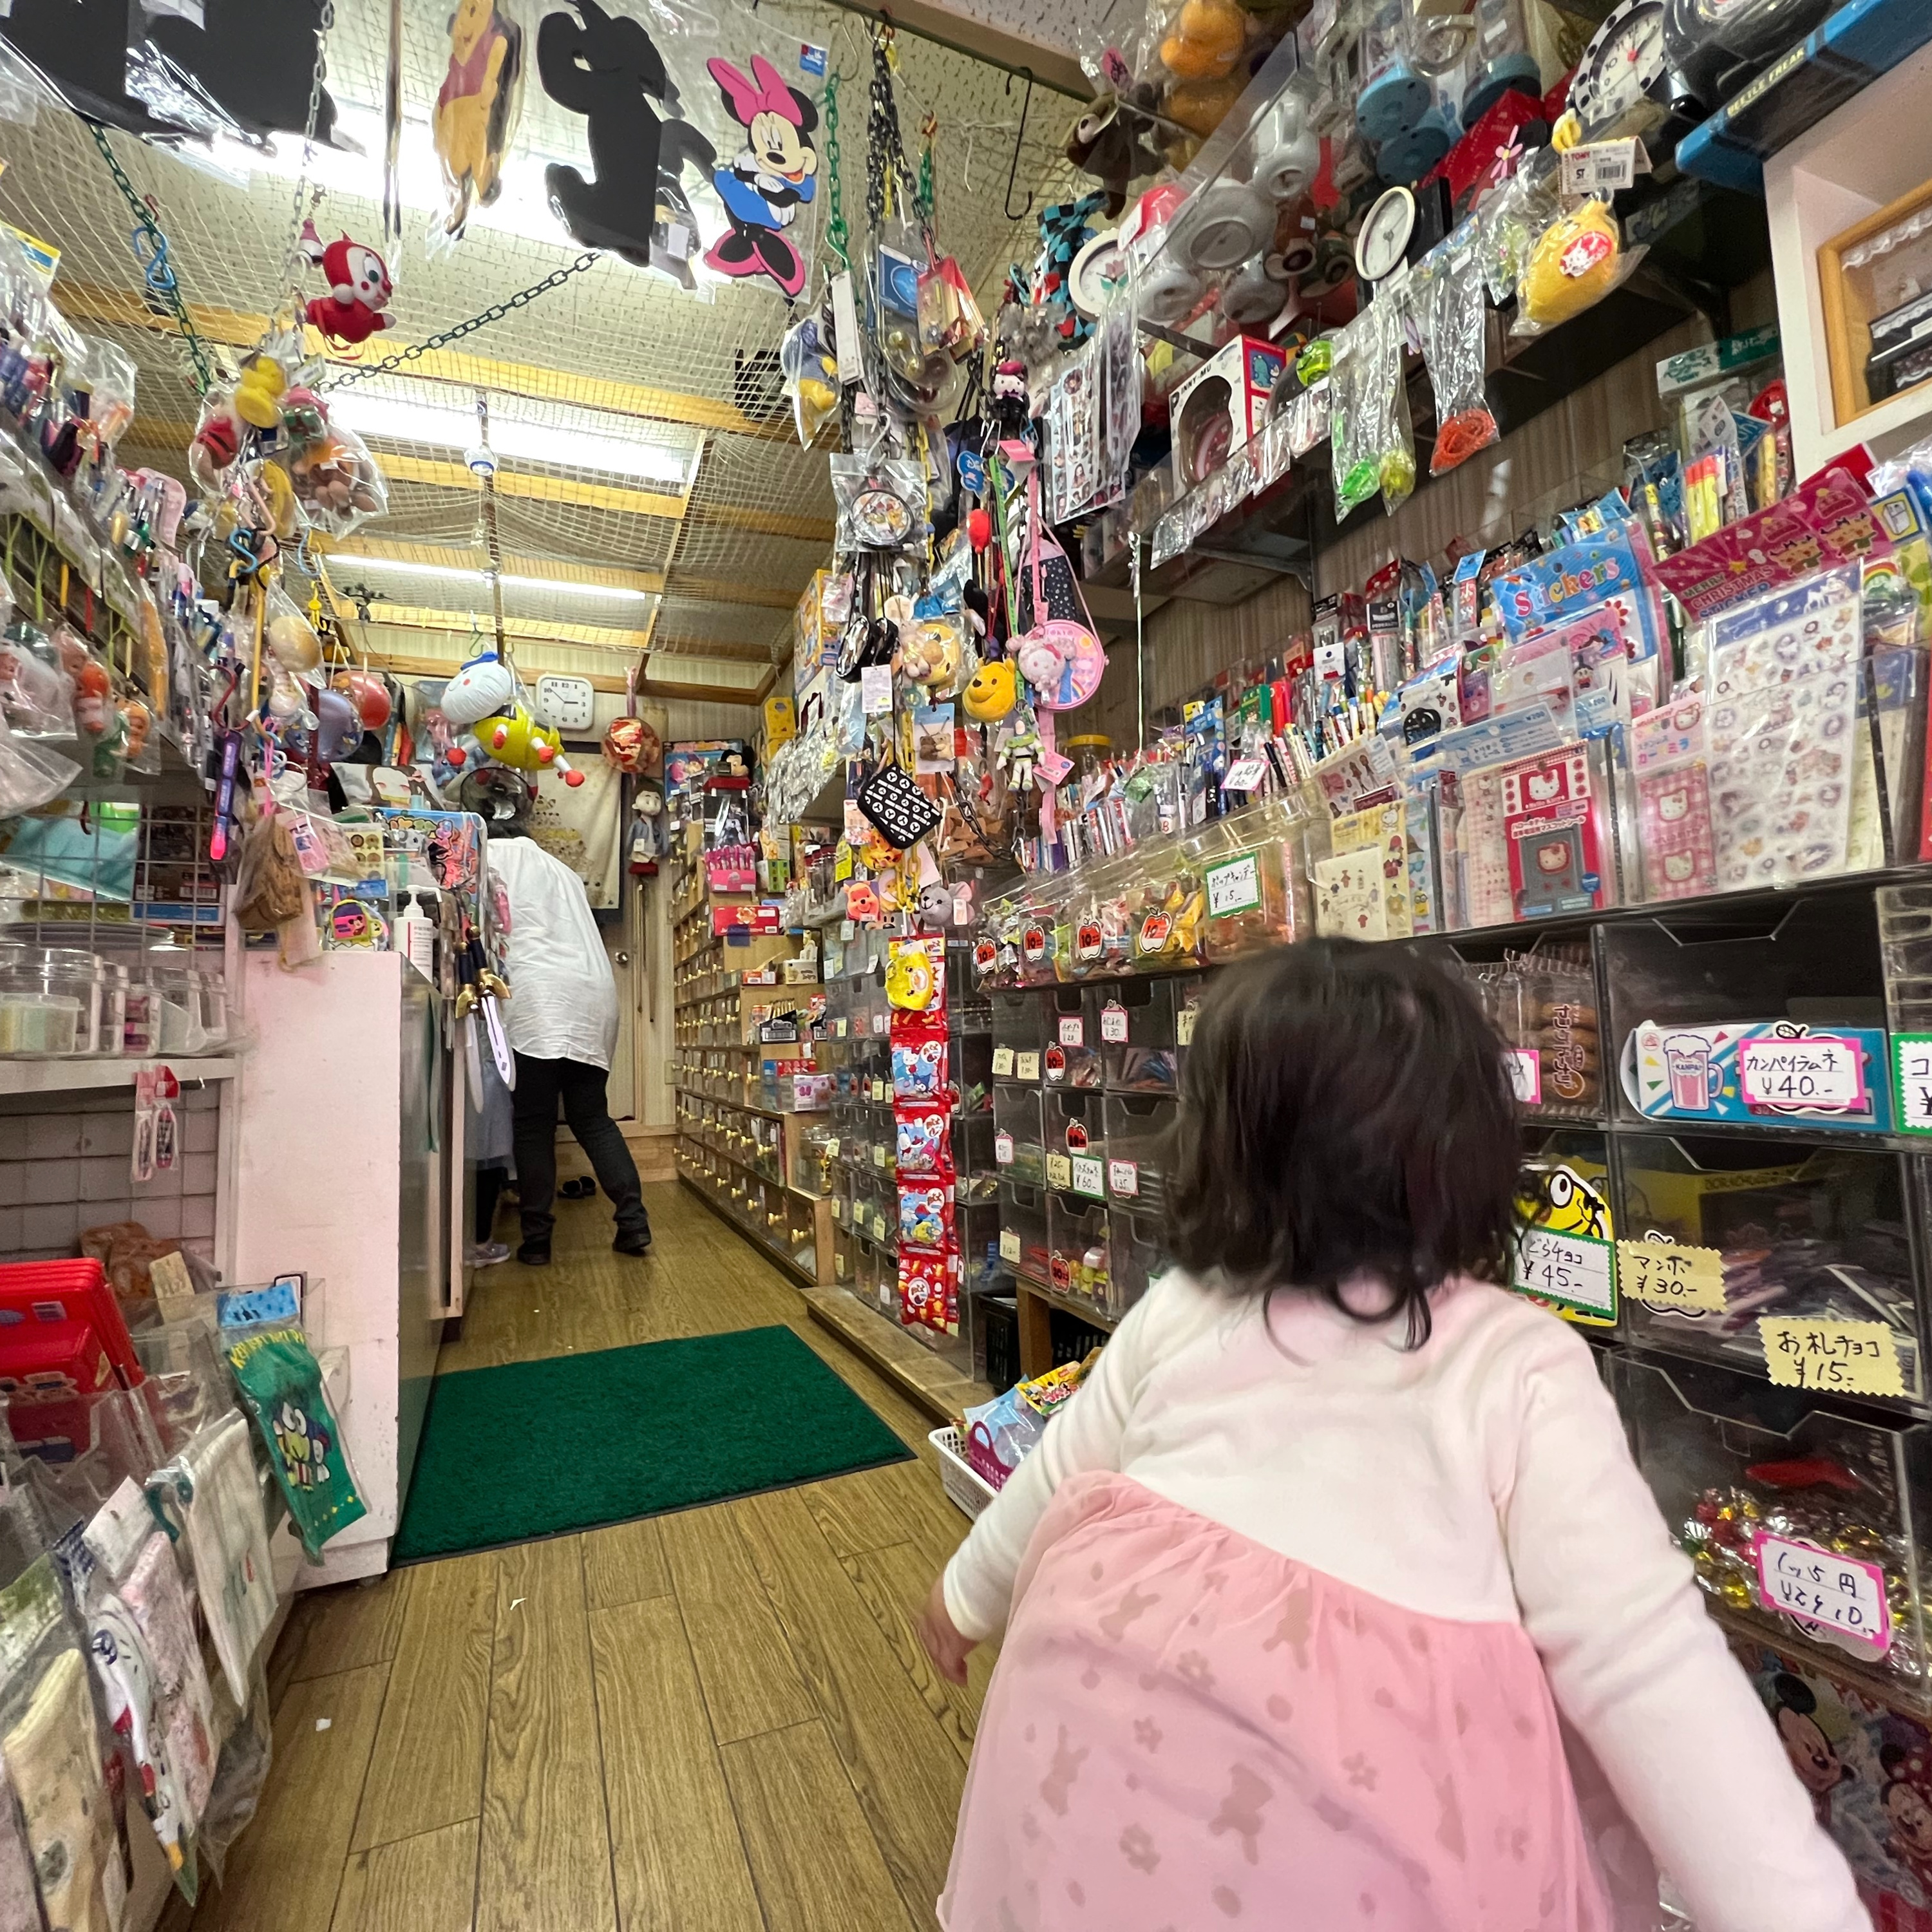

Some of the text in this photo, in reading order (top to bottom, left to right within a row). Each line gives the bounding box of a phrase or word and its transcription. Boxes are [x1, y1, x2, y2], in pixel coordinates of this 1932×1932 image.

[1515, 557, 1620, 616] Stickers
[1682, 572, 1726, 598] MERRY
[1691, 565, 1775, 609] CHRISTMAS
[1553, 1004, 1573, 1088] ヤングドーナツ
[1747, 1049, 1838, 1072] カンパイラムネ
[1528, 1238, 1583, 1265] どらチョコ
[1777, 1331, 1880, 1358] お札チョコ
